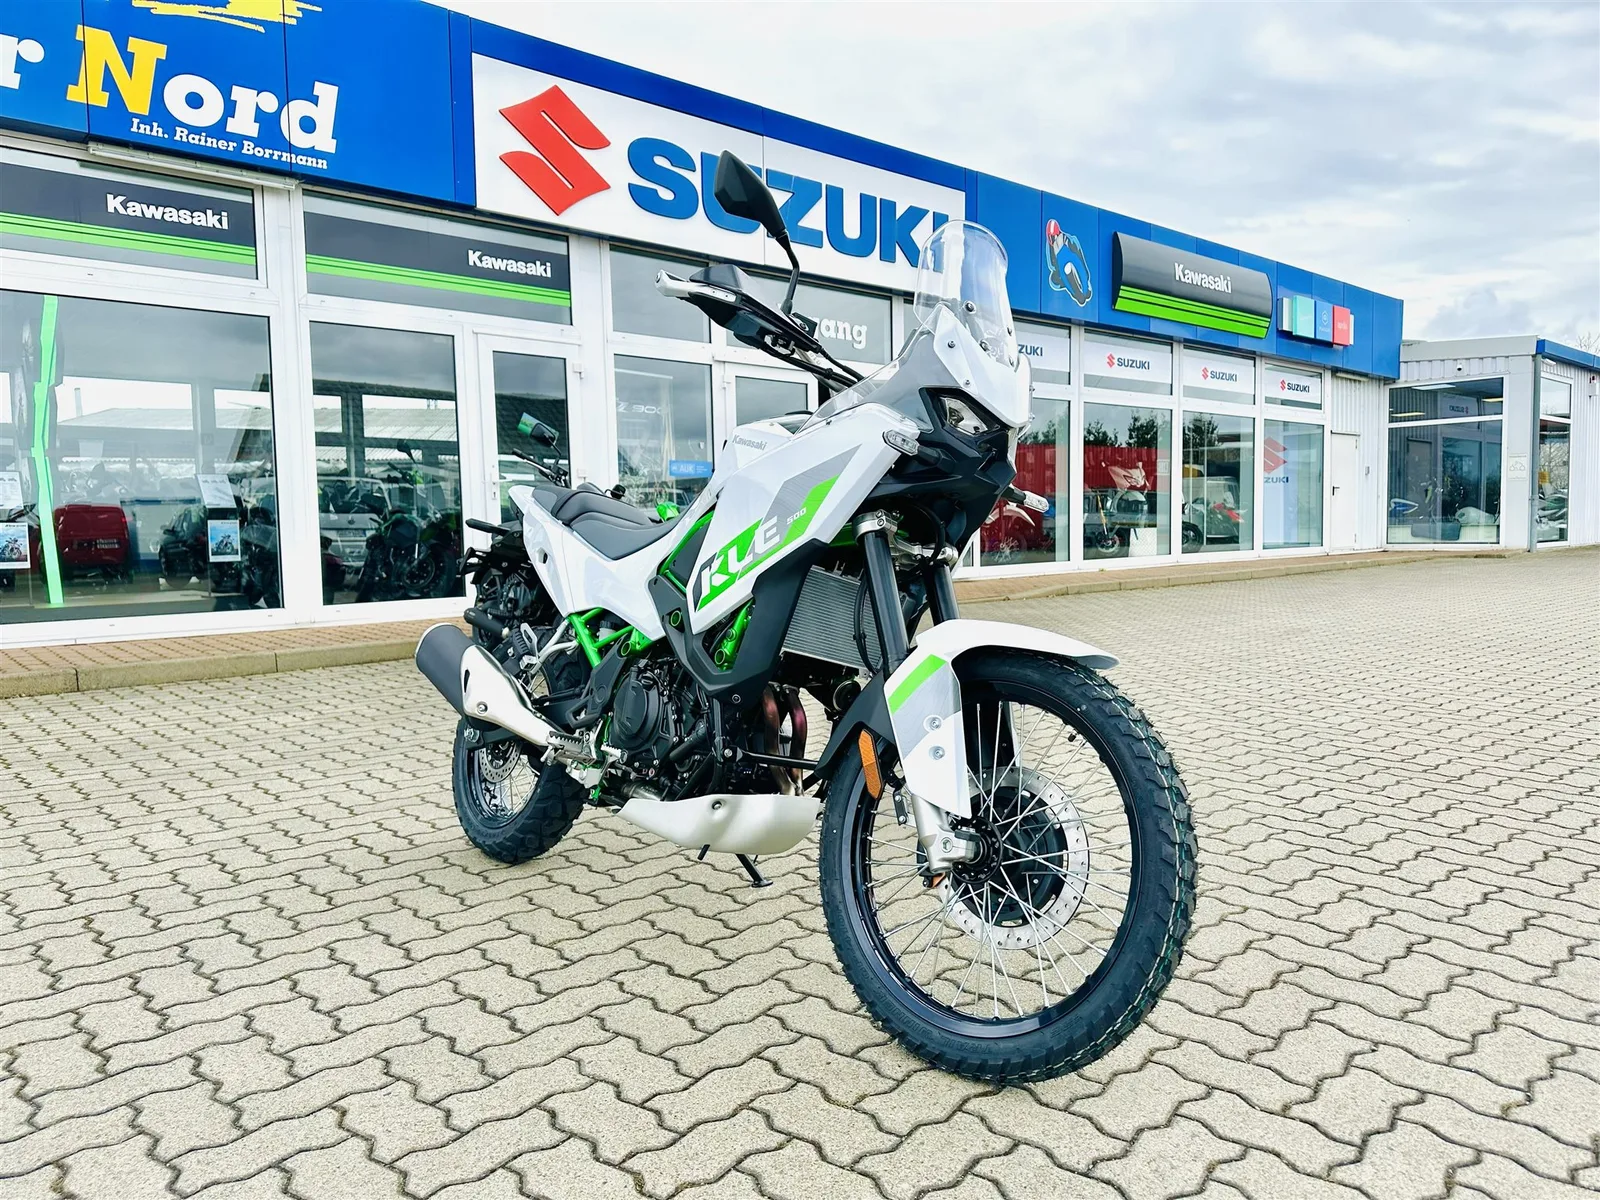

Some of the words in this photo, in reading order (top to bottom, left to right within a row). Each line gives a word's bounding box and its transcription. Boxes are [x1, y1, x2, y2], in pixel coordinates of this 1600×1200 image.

[66, 24, 339, 153] Nord
[130, 118, 169, 138] Inh.
[174, 126, 237, 152] Rainer
[242, 141, 328, 170] Borrmann
[106, 193, 229, 230] Kawasaki
[627, 136, 949, 274] SUZUKI
[467, 249, 552, 279] Kawasaki
[1174, 262, 1232, 294] Kawasaki
[1116, 357, 1151, 371] SUZUKI
[1210, 370, 1238, 382] SUZUKI
[1286, 382, 1310, 393] SUZUKI
[731, 434, 768, 451] Kawasaki
[786, 507, 807, 525] 500
[701, 515, 780, 596] KLE
